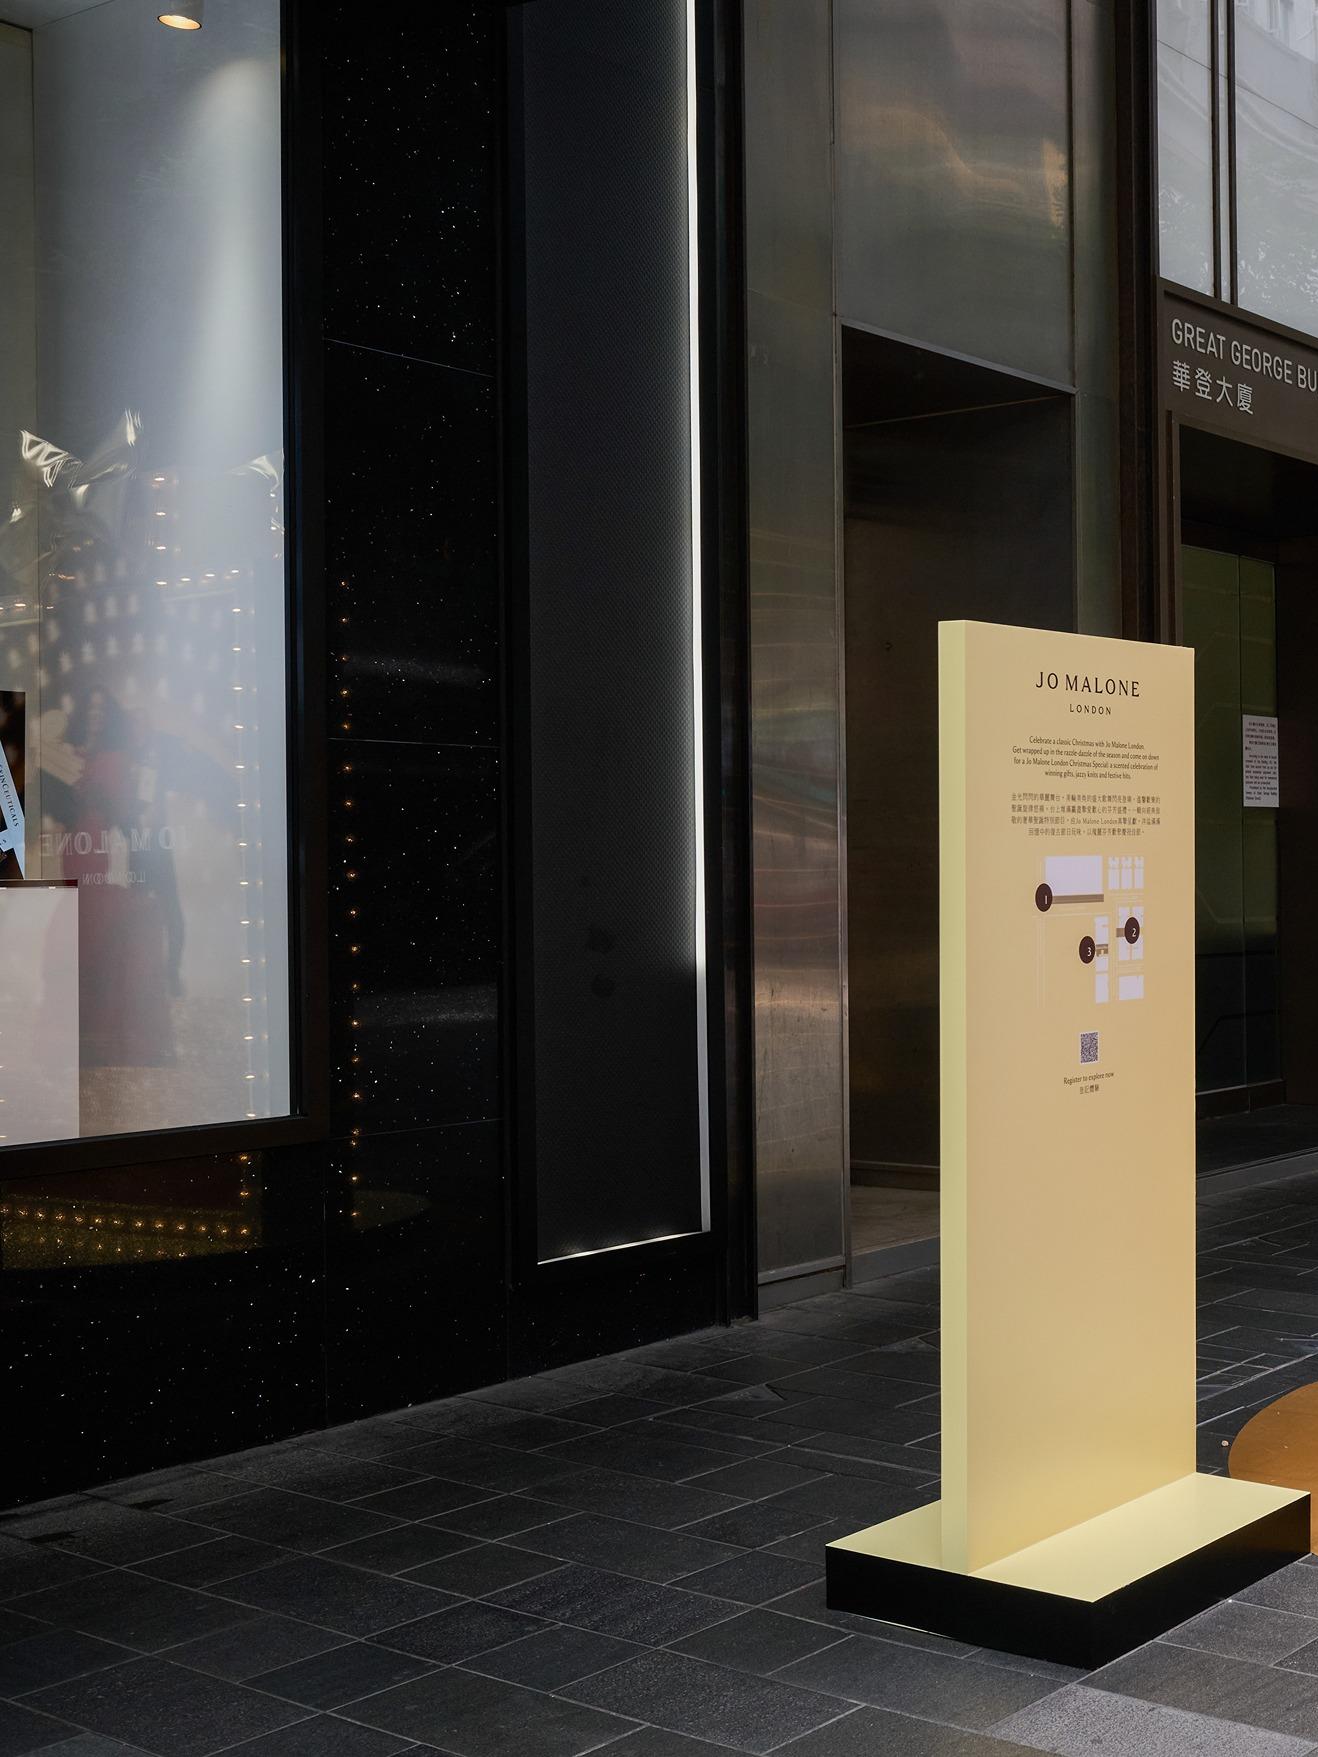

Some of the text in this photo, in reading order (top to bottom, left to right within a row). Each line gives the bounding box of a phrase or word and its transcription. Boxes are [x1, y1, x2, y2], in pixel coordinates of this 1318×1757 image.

[1171, 318, 1226, 360] GREAT
[1231, 340, 1293, 385] GEORGE
[1036, 671, 1140, 697] JO MALONE
[1069, 703, 1112, 716] LONDON
[1029, 736, 1051, 744] Celebrate
[1072, 739, 1095, 747] Christmas
[1112, 741, 1127, 749] Malone
[1023, 747, 1042, 756] wrapped
[1069, 759, 1091, 767] Christmas
[1075, 771, 1086, 779] jazzy
[1108, 771, 1121, 779] festive
[1063, 1076, 1082, 1086] Register
[1088, 1072, 1105, 1082] explore
[1105, 1071, 1114, 1079] now
